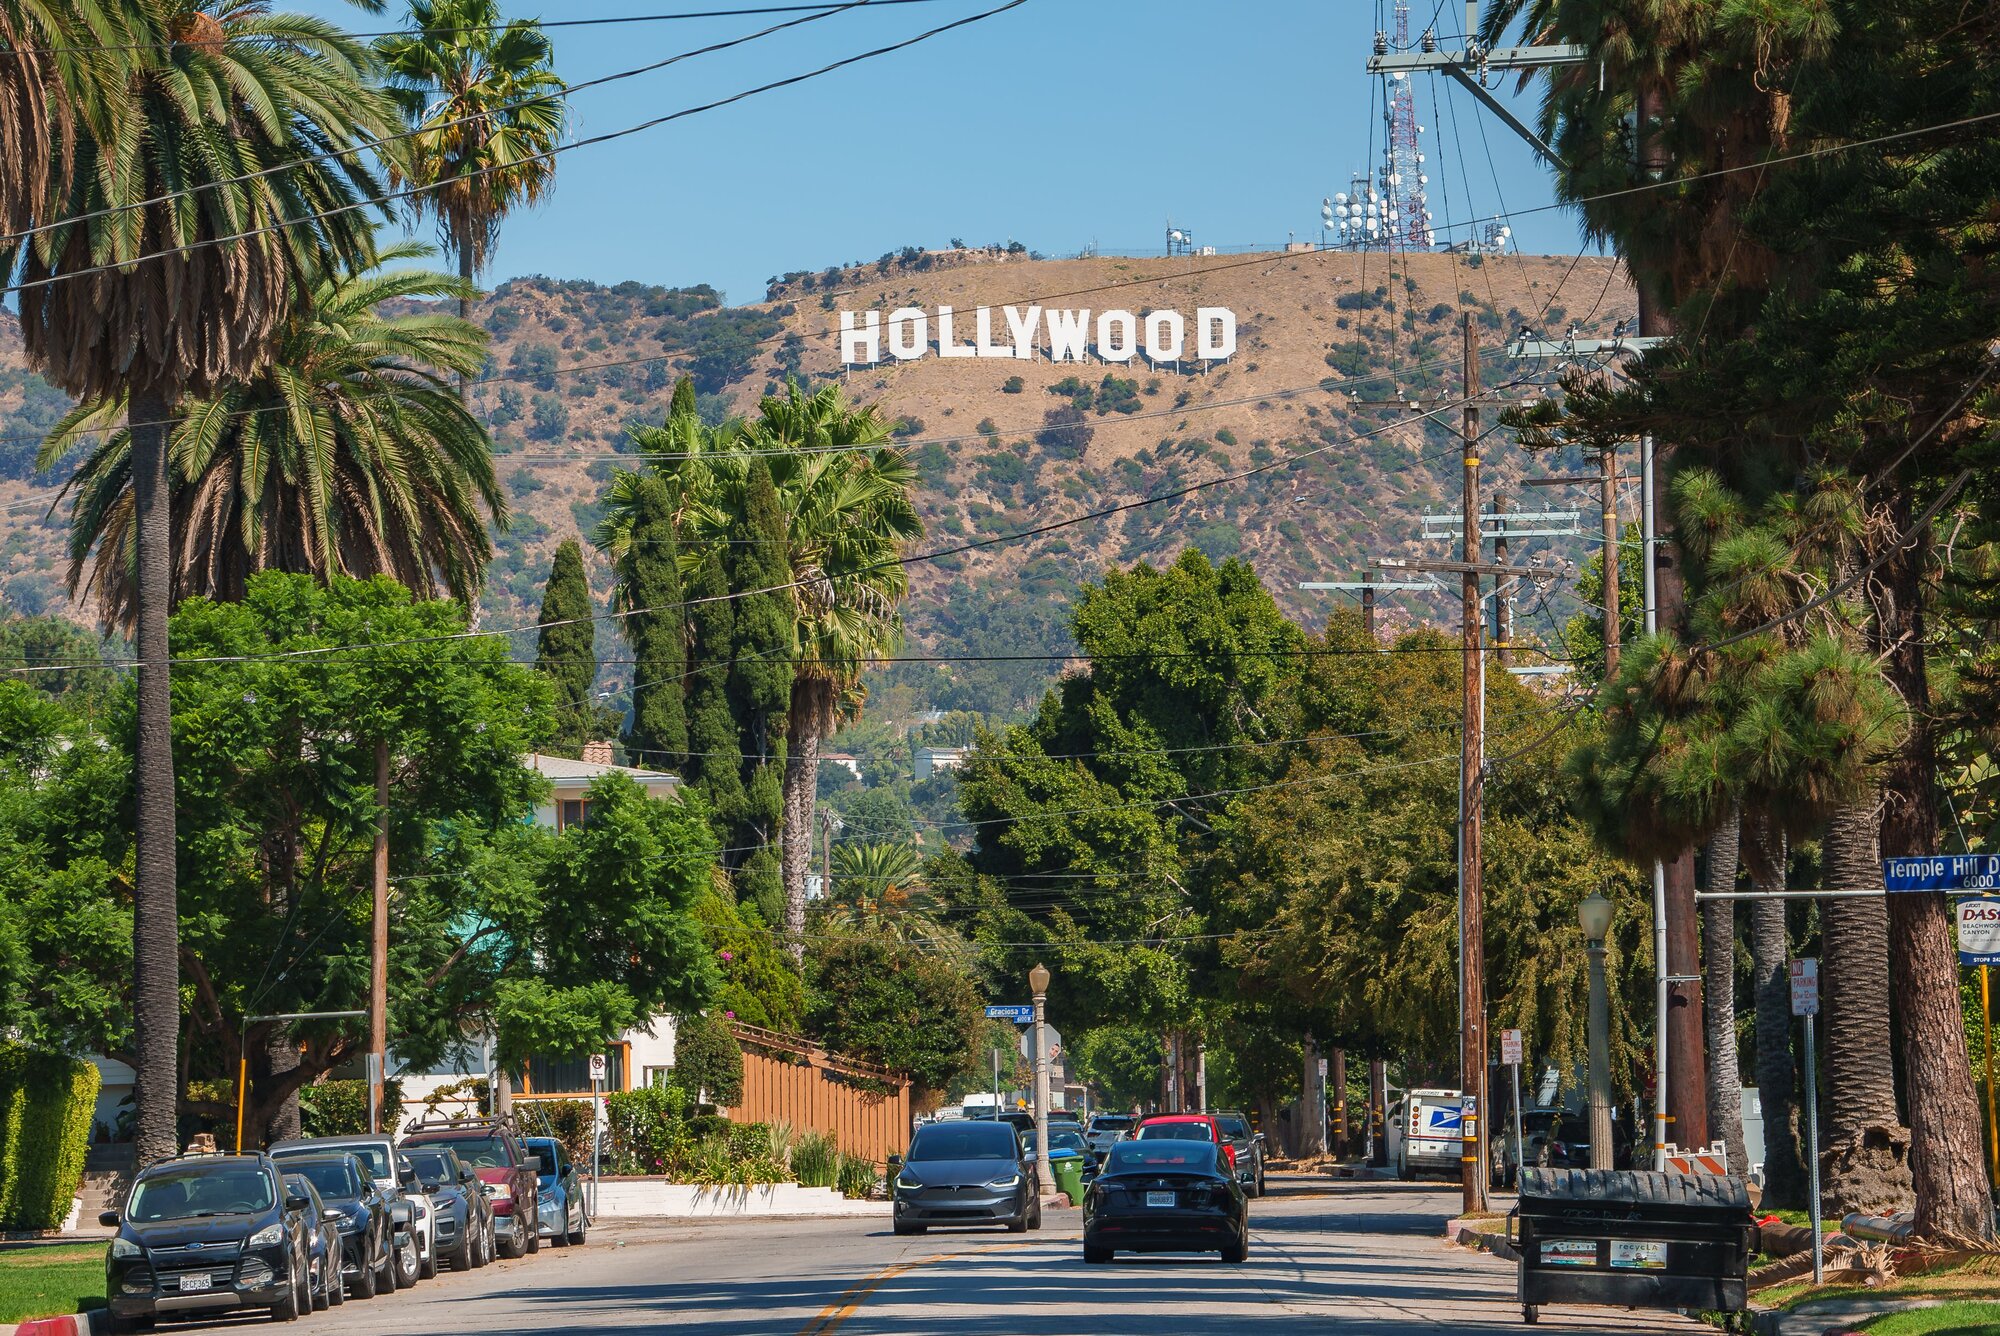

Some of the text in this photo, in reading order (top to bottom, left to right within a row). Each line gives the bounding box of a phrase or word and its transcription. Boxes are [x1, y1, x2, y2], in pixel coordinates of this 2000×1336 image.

[840, 306, 1237, 363] HOLLYWOOD
[1888, 856, 2000, 881] Temple Hill D
[1964, 874, 1994, 888] 6000
[1962, 909, 2000, 921] DAS
[1792, 961, 1802, 975] NO
[1793, 976, 1816, 988] PARKING
[990, 1007, 1018, 1015] Graciosa
